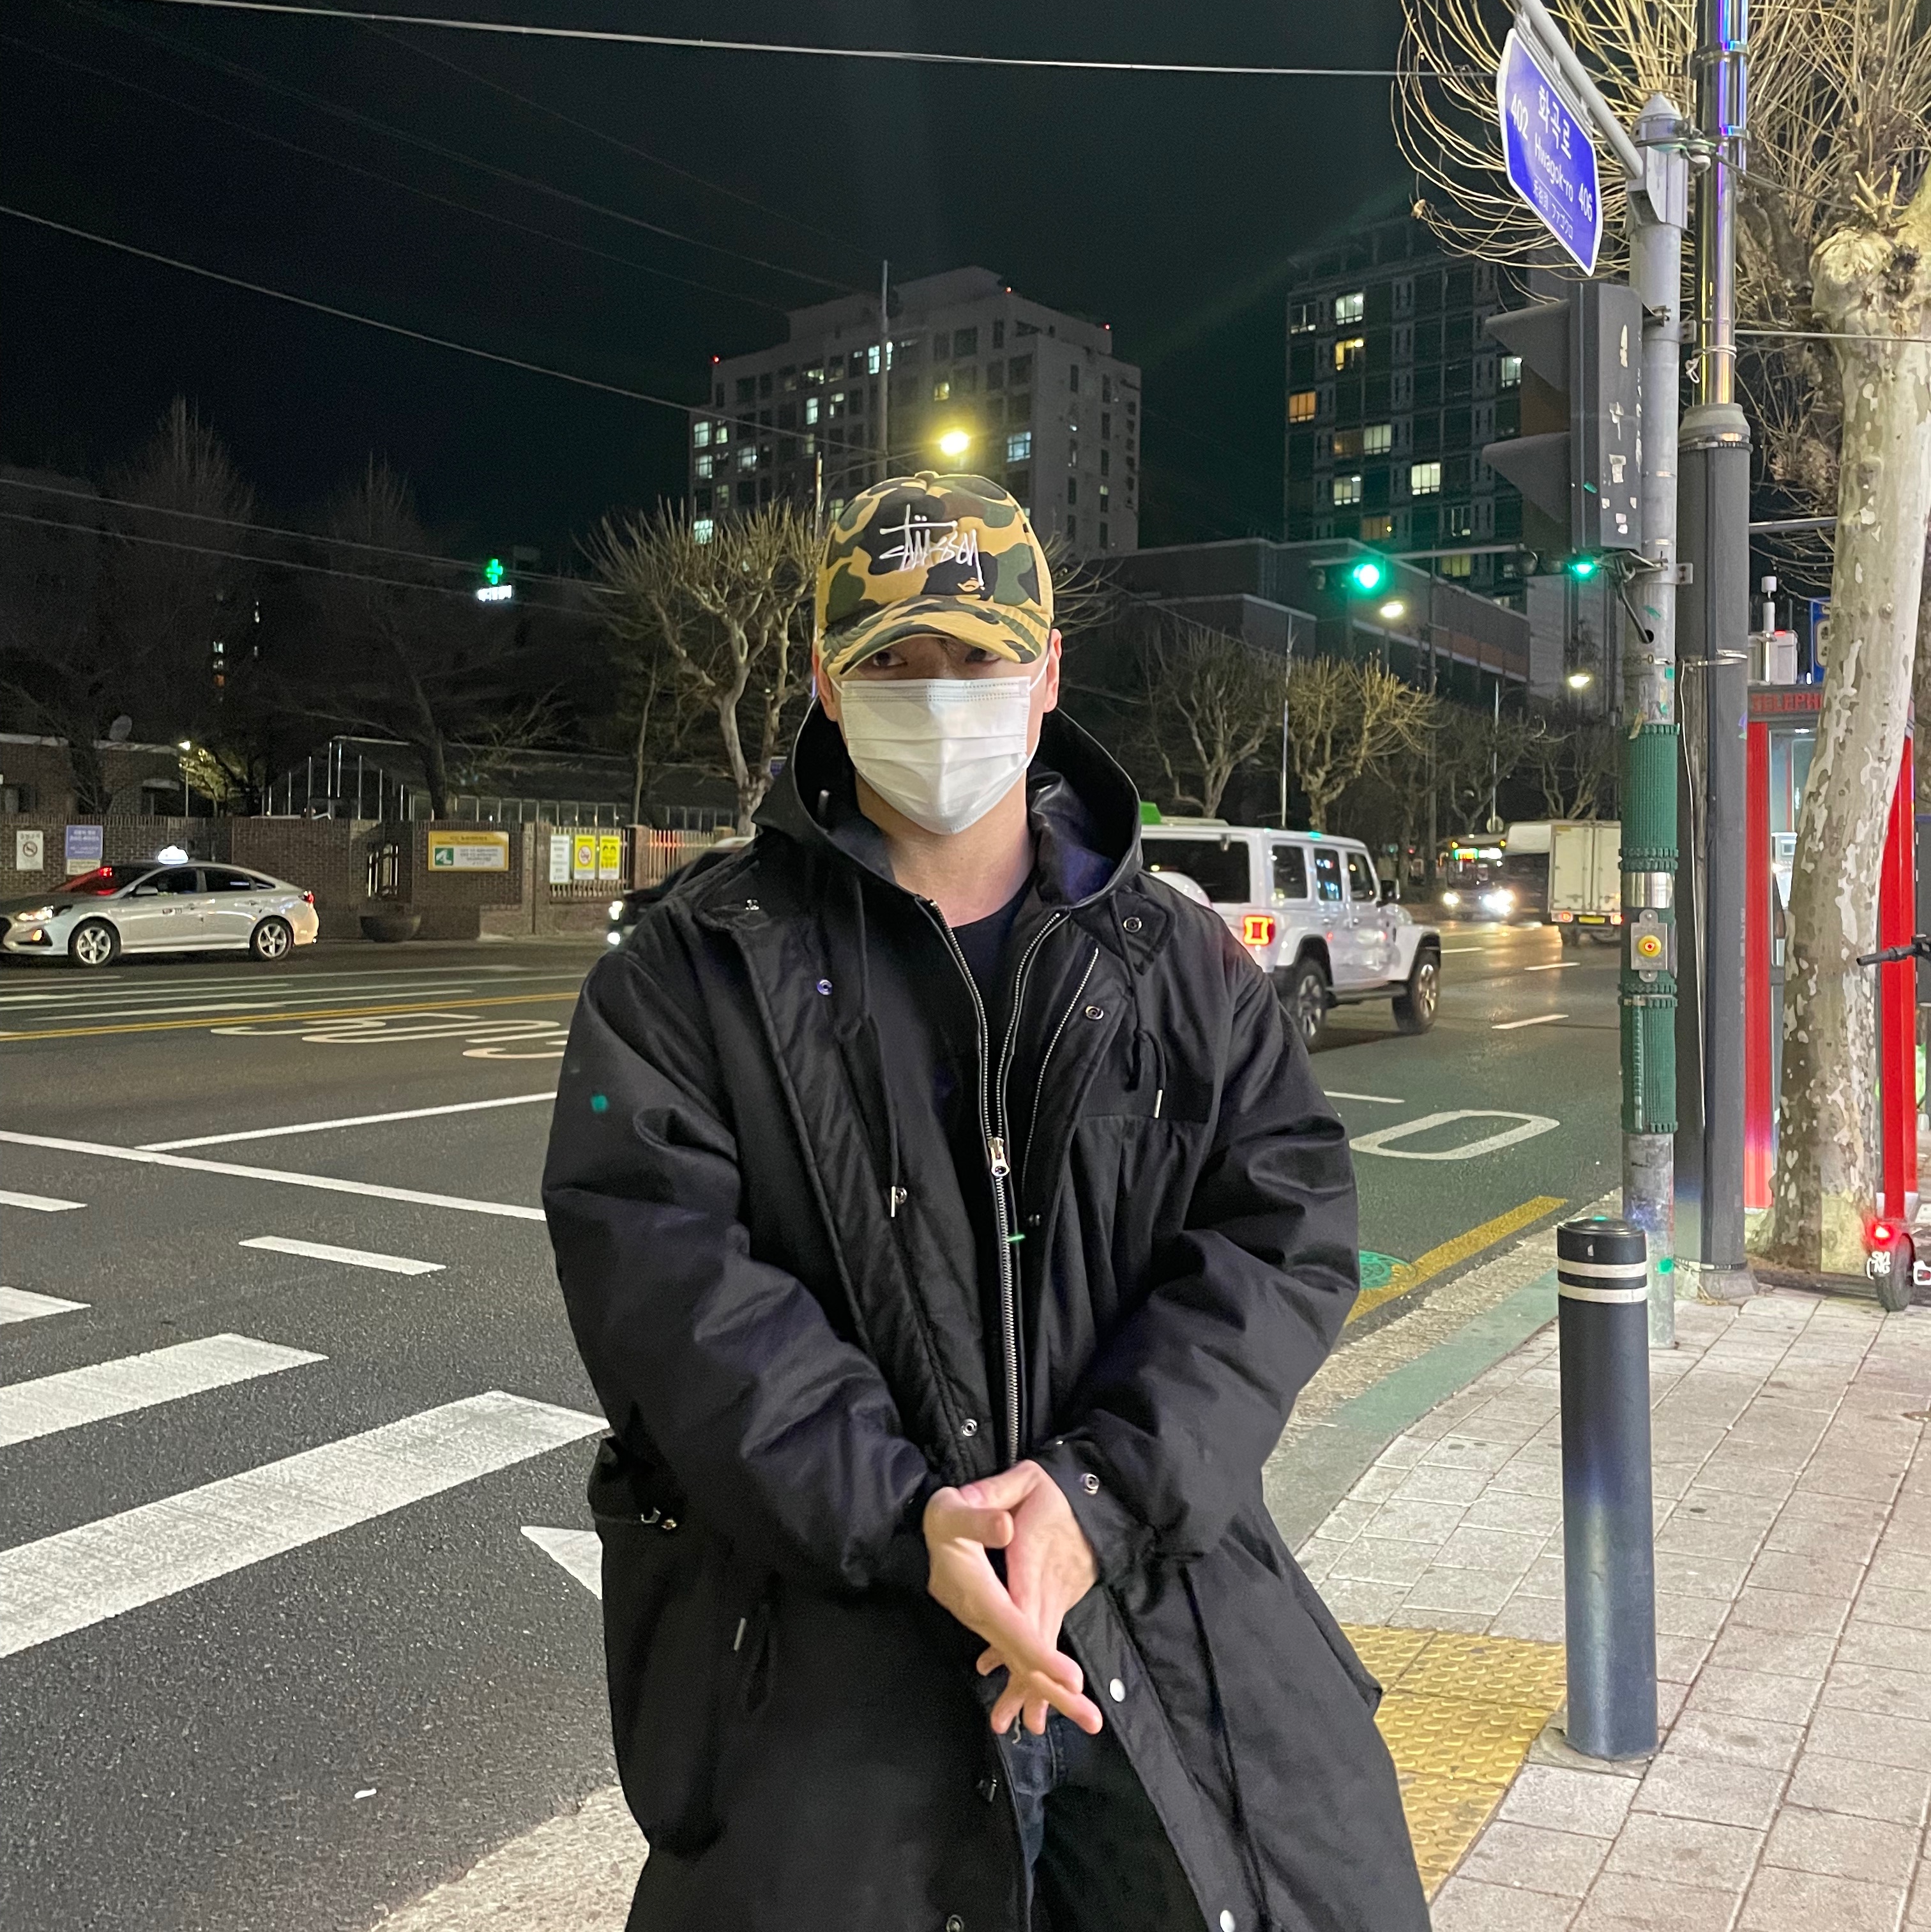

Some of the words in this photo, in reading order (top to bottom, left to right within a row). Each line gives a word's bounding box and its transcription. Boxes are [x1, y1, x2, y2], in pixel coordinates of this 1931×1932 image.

[1511, 93, 1528, 140] 402
[1538, 84, 1571, 160] 화곡로
[1535, 132, 1573, 202] Hwagok-ro
[1579, 183, 1593, 222] 406
[1752, 693, 1824, 712] TELEPH
